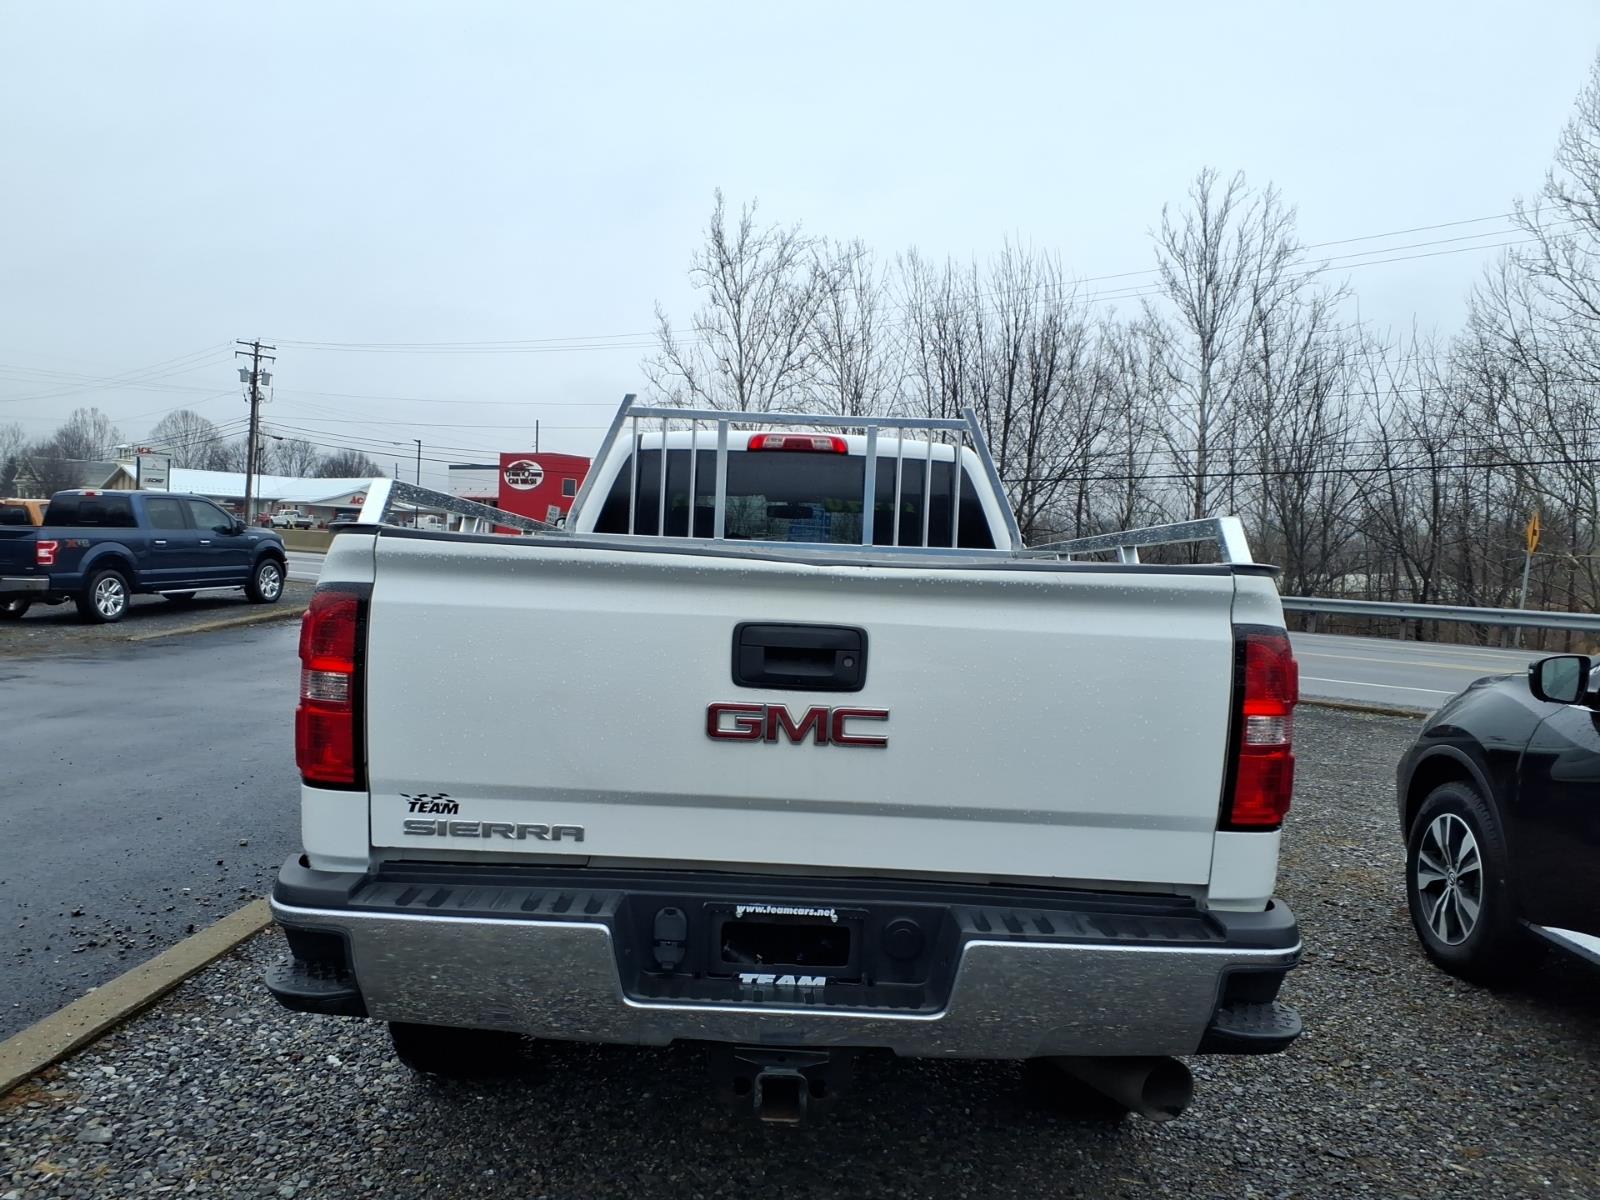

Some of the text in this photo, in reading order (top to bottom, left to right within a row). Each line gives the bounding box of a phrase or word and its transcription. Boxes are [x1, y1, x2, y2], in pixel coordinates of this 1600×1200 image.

[350, 495, 365, 504] AC
[706, 701, 890, 748] GMC
[408, 801, 460, 815] TEAM
[403, 818, 585, 842] SIERRA
[736, 904, 836, 917] www.teamcars.net
[738, 973, 827, 986] TEAM
